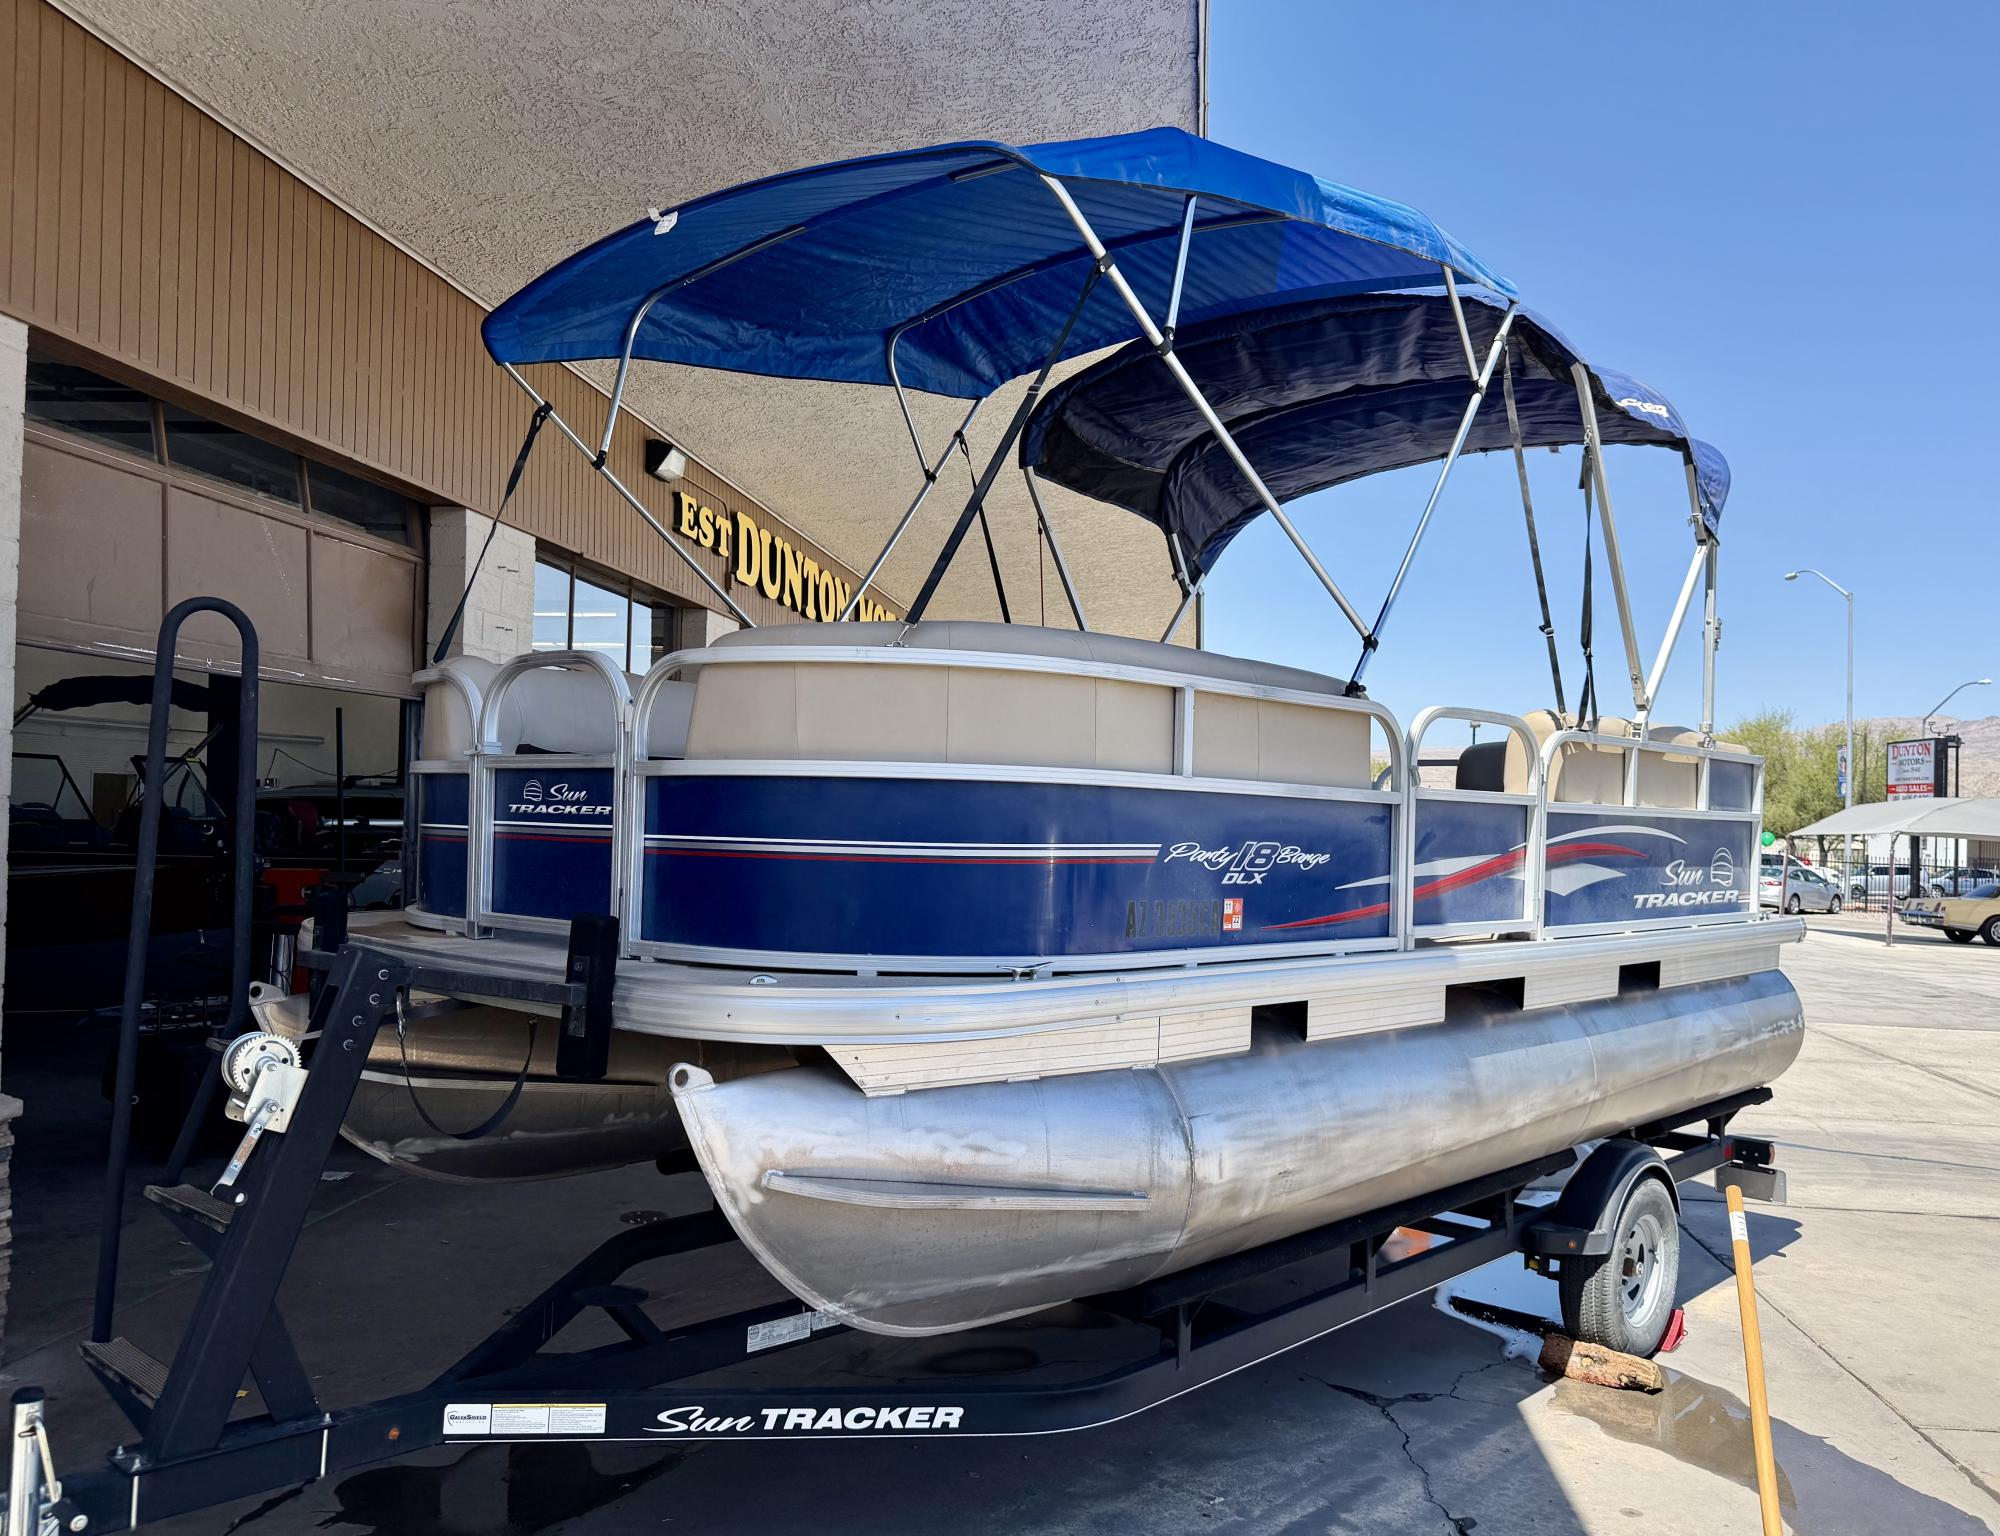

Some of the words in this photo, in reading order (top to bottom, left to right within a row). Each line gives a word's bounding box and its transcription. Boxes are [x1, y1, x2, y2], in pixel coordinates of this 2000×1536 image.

[680, 491, 732, 557] EST
[737, 511, 850, 622] DUNTON
[1892, 743, 1931, 760] DUNTON
[1898, 757, 1925, 766] MOTORS
[545, 783, 588, 801] Sun
[508, 804, 612, 815] TRACKER
[1164, 842, 1238, 871] Party
[1229, 841, 1281, 871] 18
[1276, 846, 1331, 870] Barge
[1221, 872, 1268, 885] DLX
[1659, 859, 1704, 886] Sun
[1633, 889, 1739, 910] TRACKER
[642, 1406, 756, 1432] Sun
[760, 1406, 965, 1430] TRACKER
